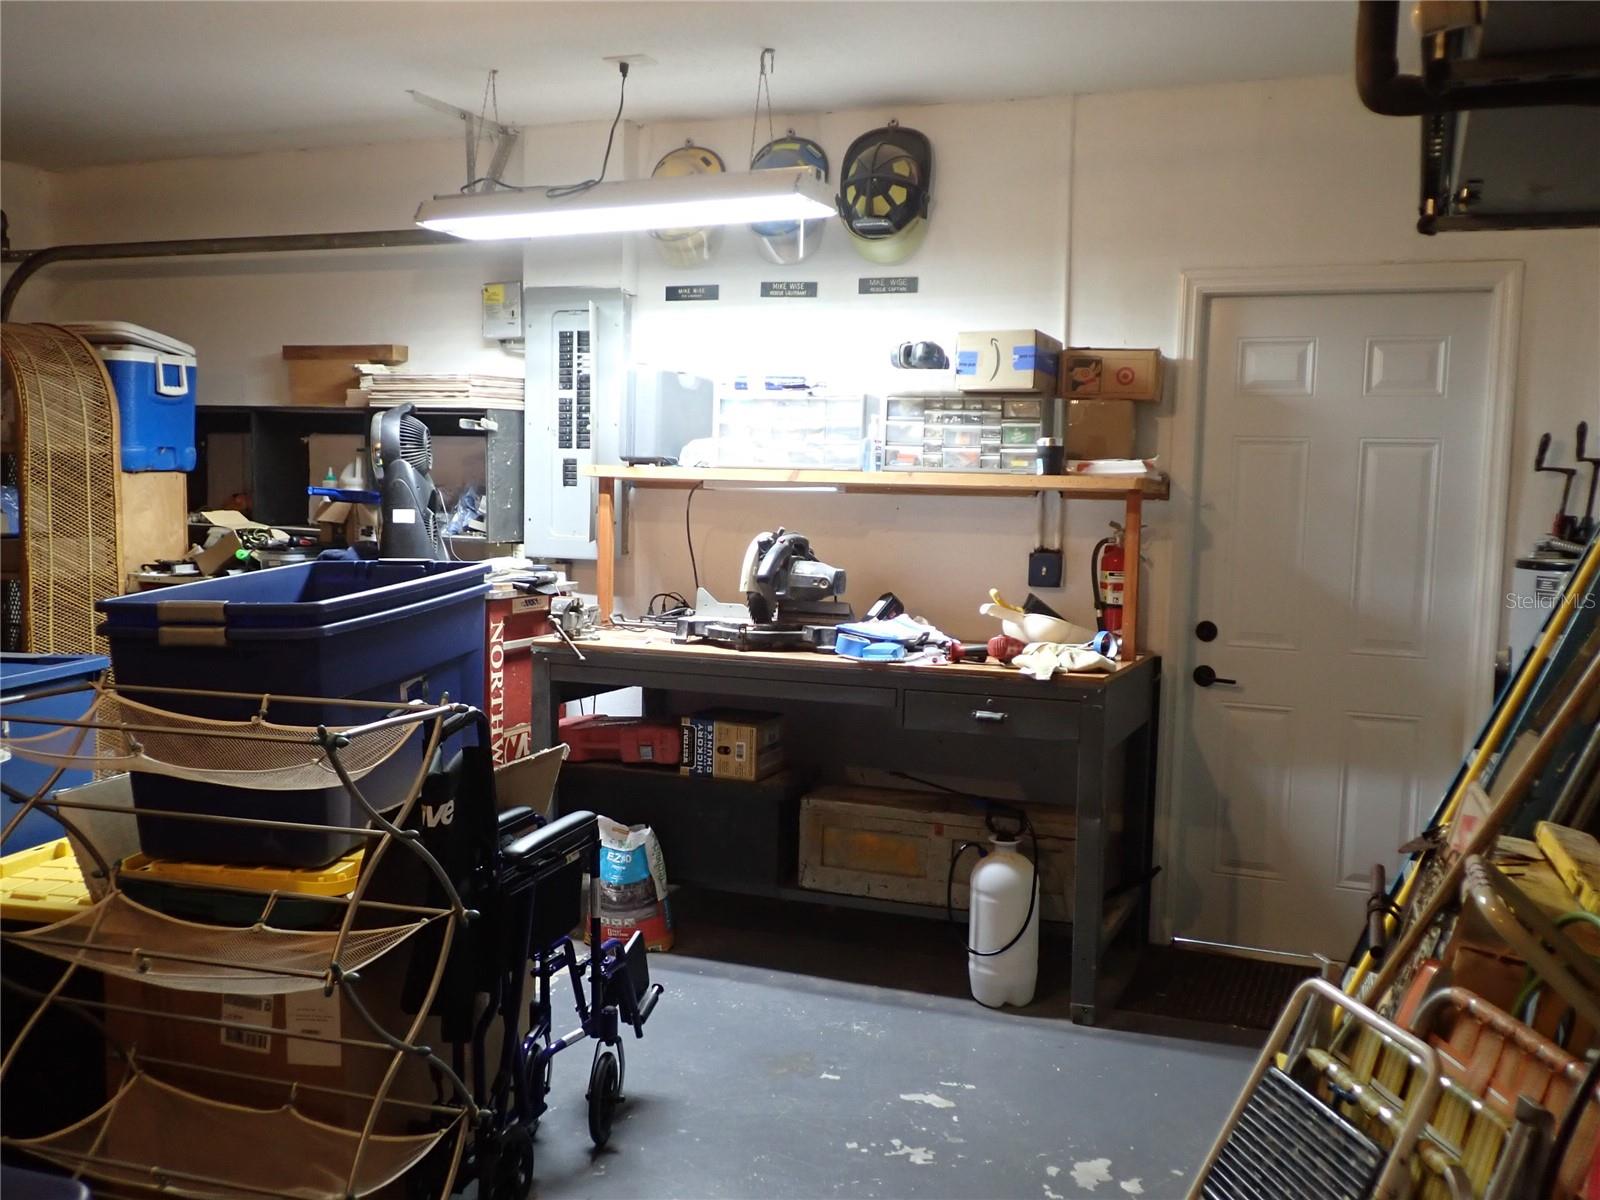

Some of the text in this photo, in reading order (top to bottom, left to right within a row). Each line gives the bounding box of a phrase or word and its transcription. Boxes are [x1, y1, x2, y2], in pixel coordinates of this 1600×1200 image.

[772, 282, 806, 290] MIKE WISE
[421, 800, 455, 828] ve
